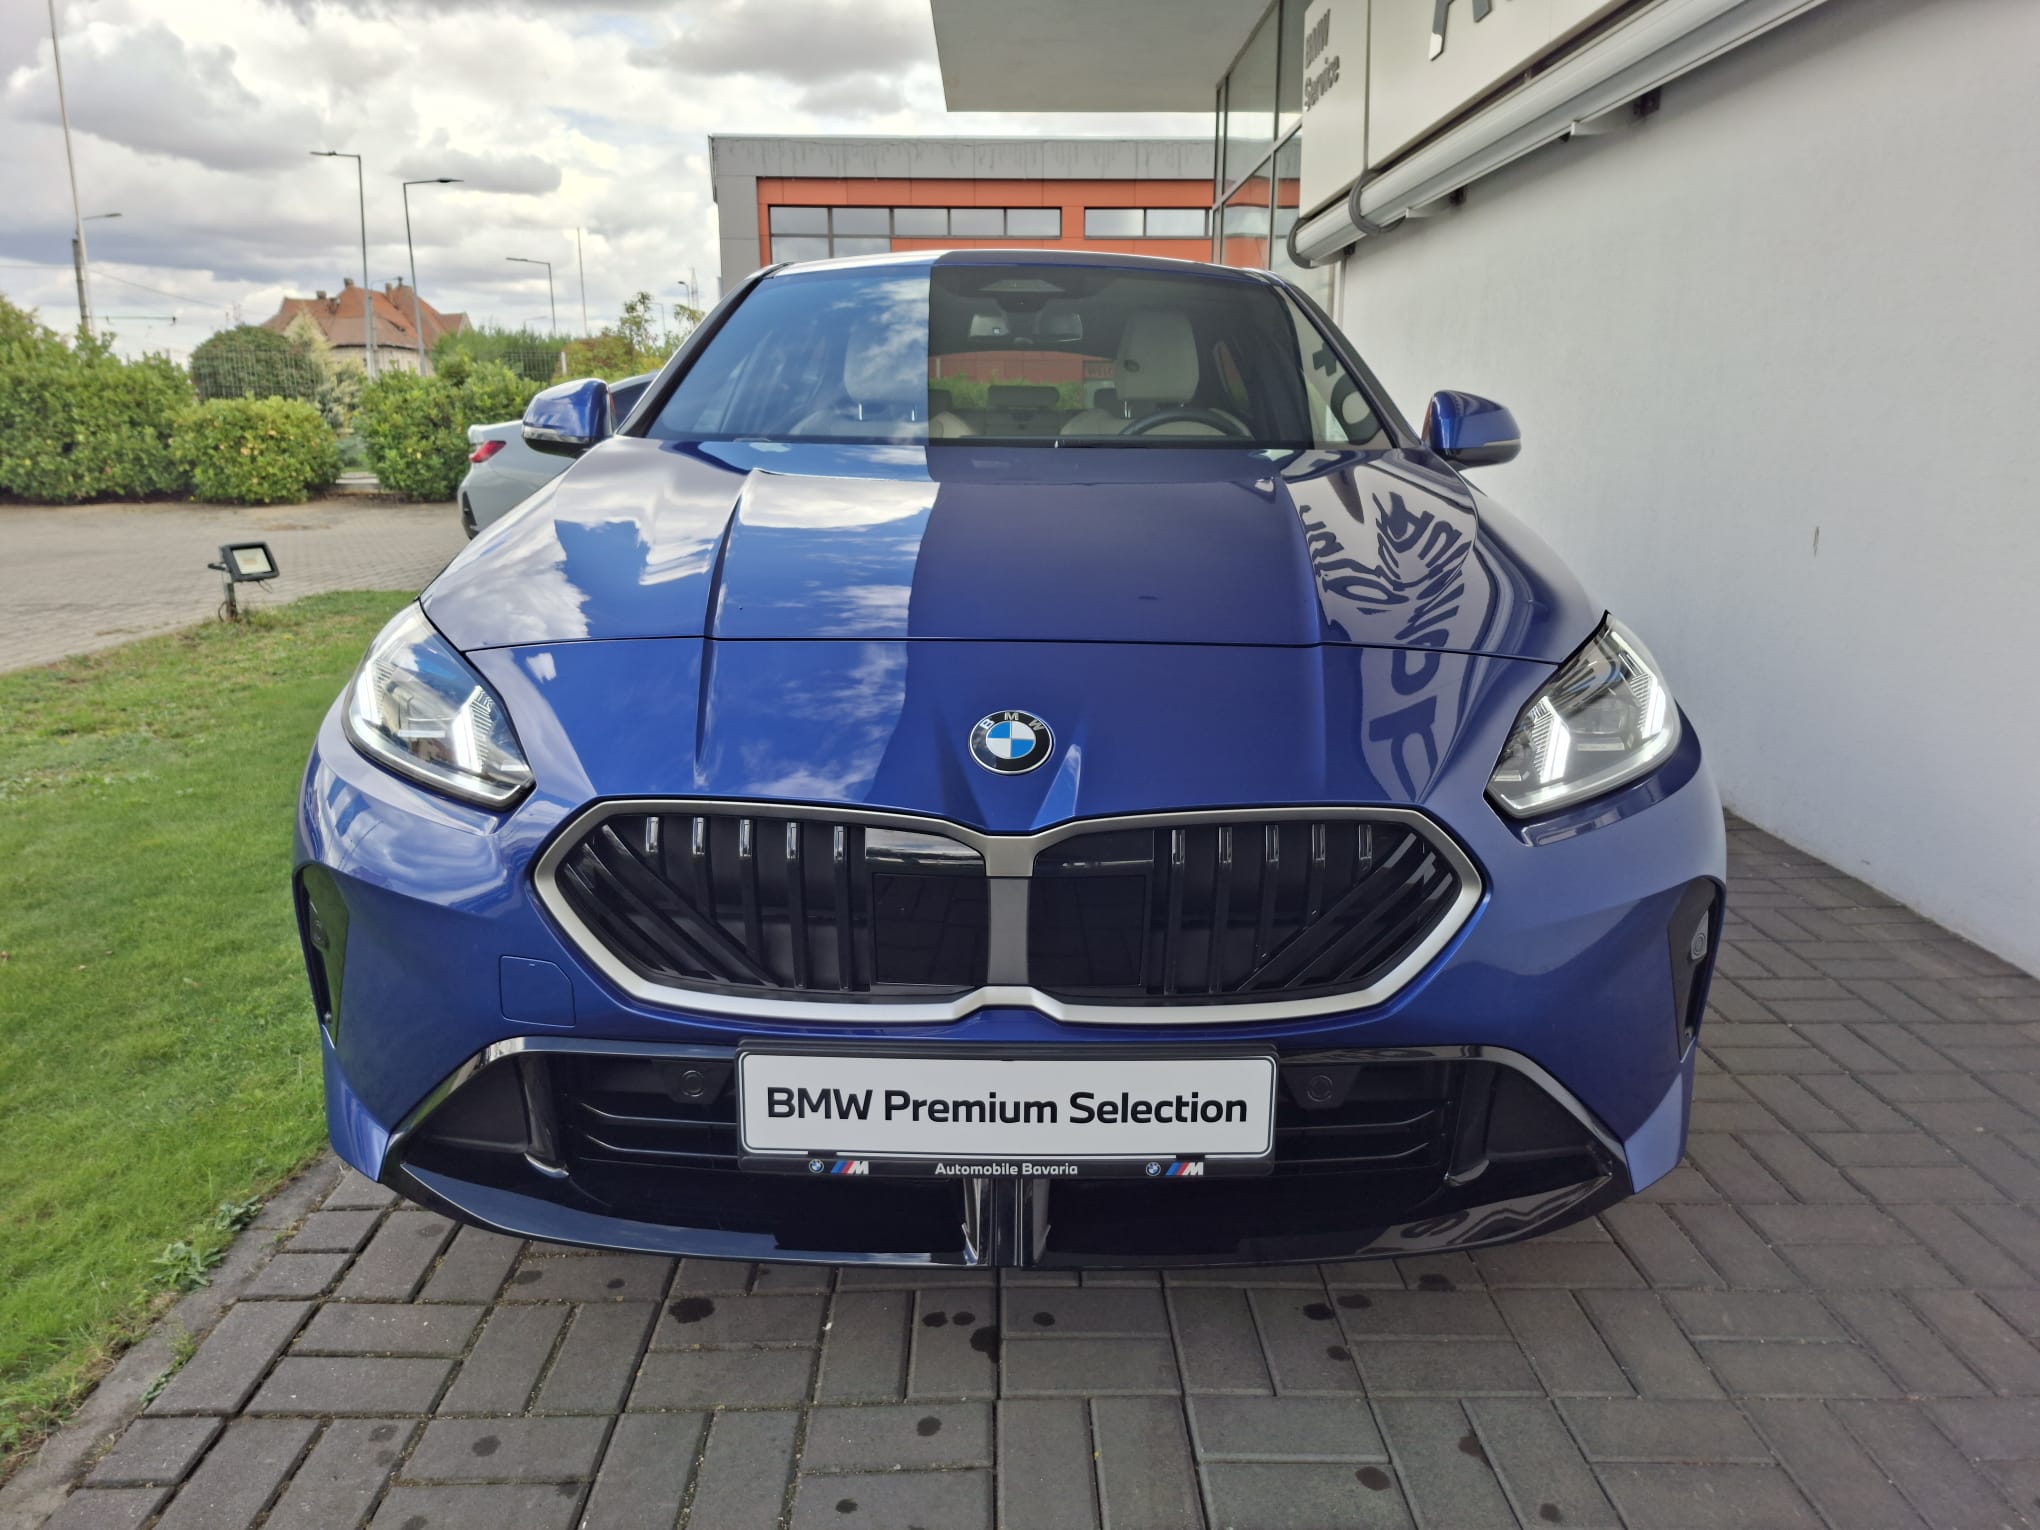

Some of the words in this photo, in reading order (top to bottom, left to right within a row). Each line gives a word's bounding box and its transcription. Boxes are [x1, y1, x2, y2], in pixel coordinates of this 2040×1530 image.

[1305, 8, 1331, 70] BMW
[1304, 56, 1340, 112] Service
[767, 1087, 873, 1120] BMW
[885, 1089, 1058, 1124] Premium
[1069, 1091, 1248, 1124] Selection
[934, 1162, 1019, 1176] Automobile
[1022, 1162, 1078, 1176] Bavaria
